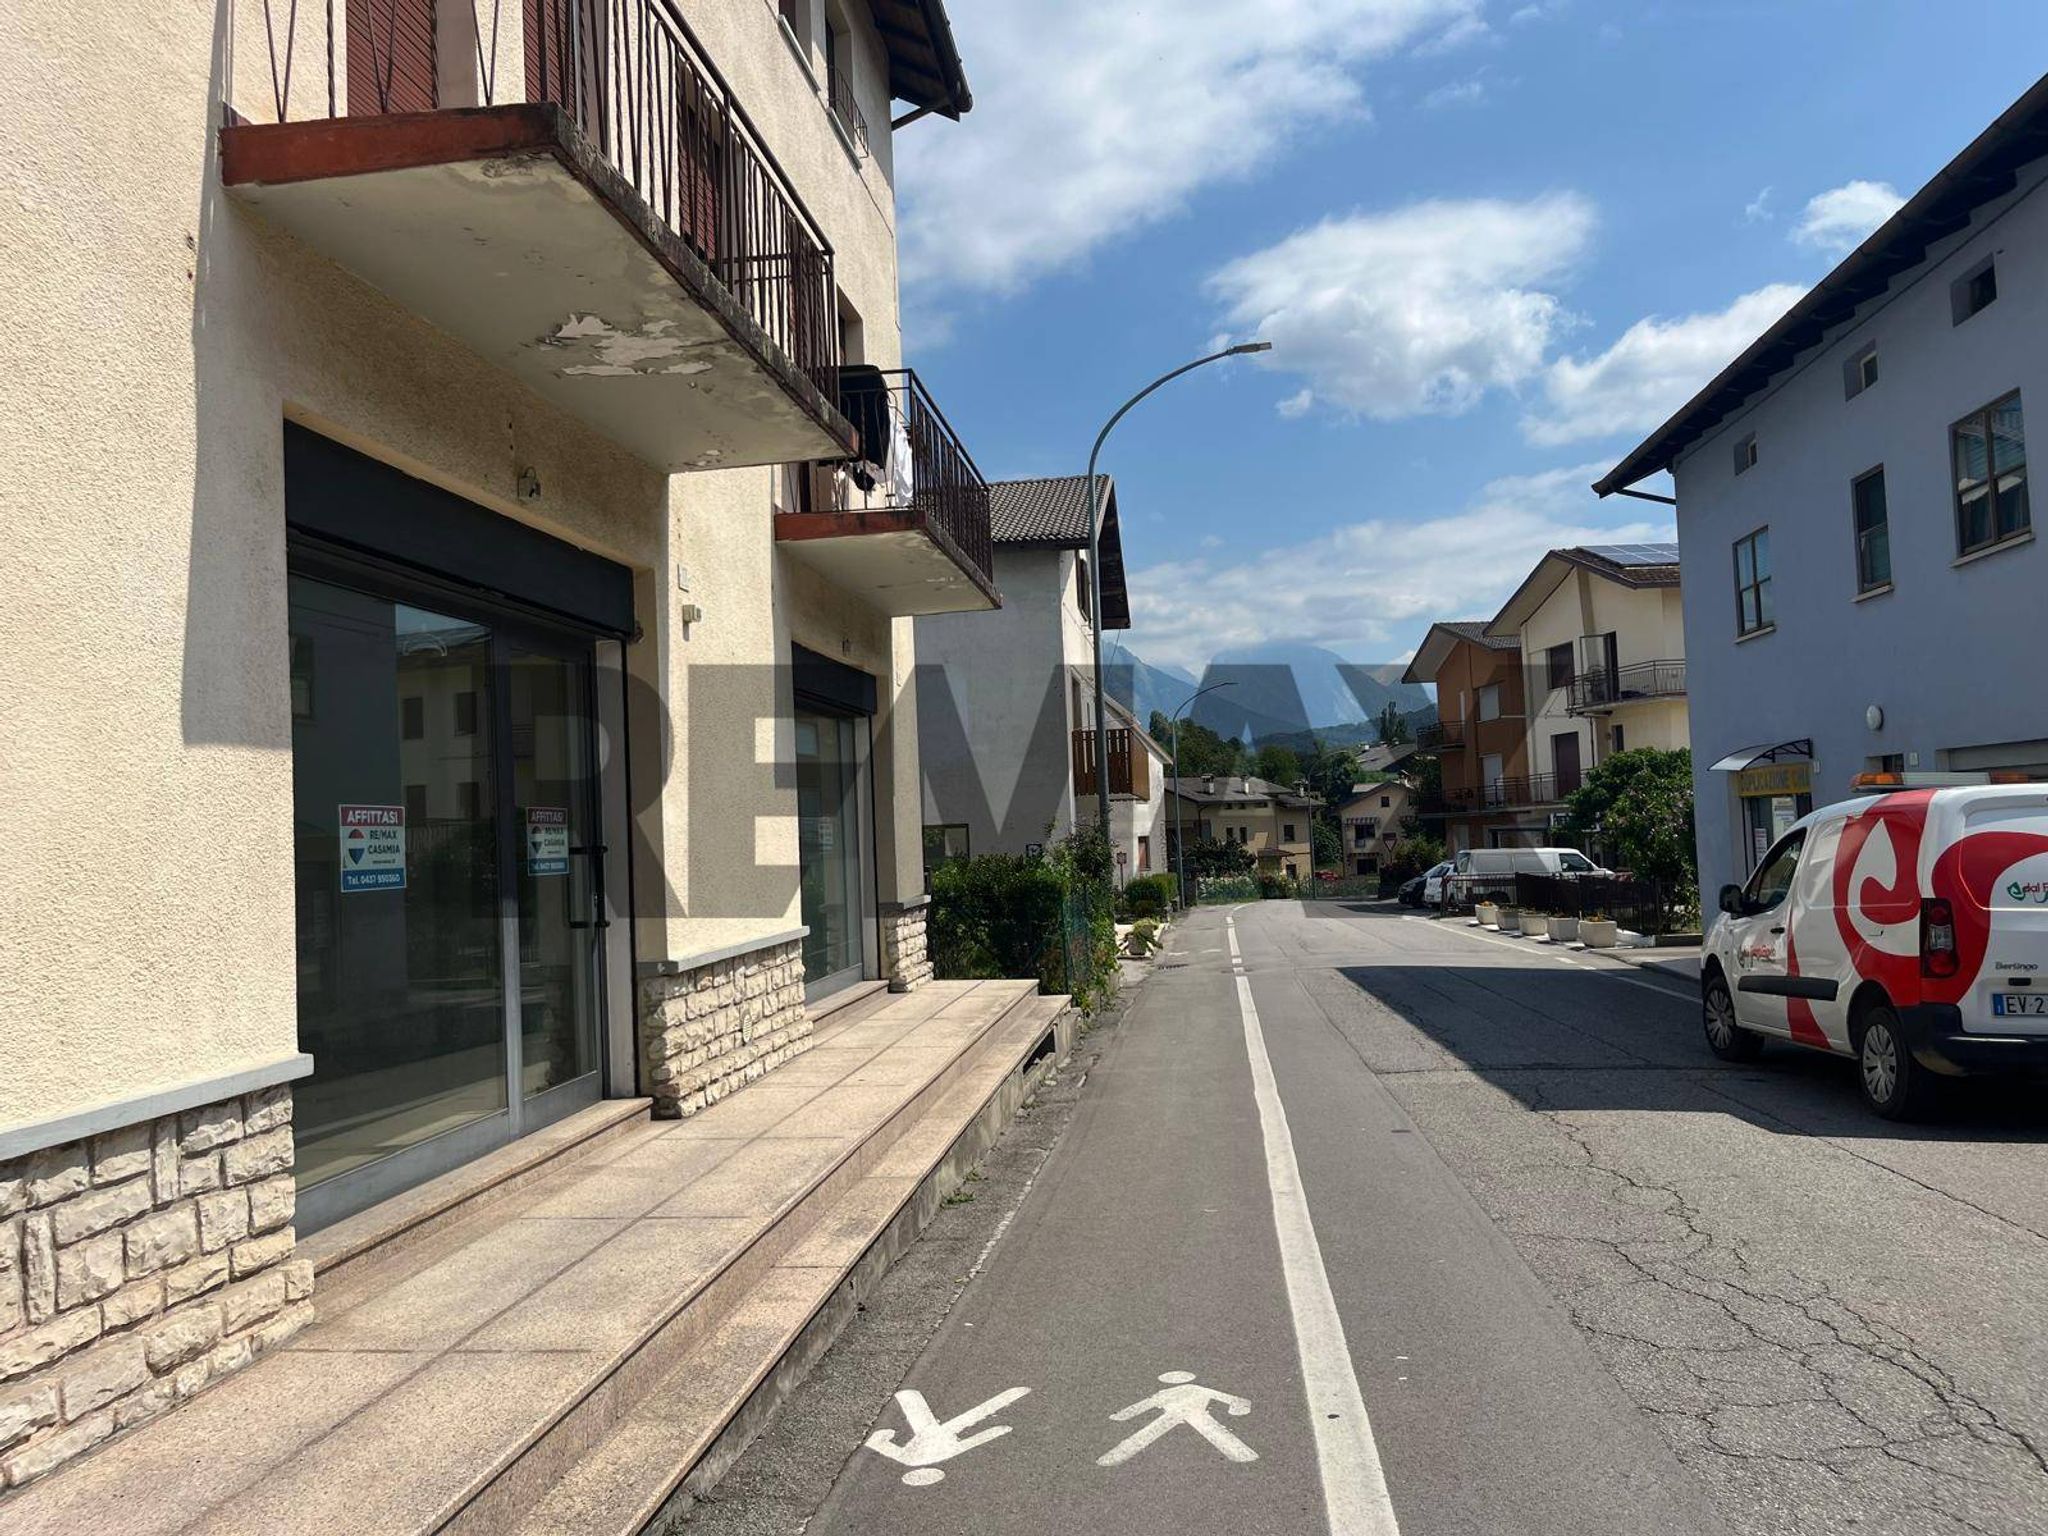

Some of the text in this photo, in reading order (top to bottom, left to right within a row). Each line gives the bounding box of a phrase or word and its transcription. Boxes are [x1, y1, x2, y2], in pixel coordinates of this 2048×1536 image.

[347, 809, 399, 825] AFFITTASI
[369, 829, 397, 840] RE/MAX
[368, 844, 401, 855] CASAMIA
